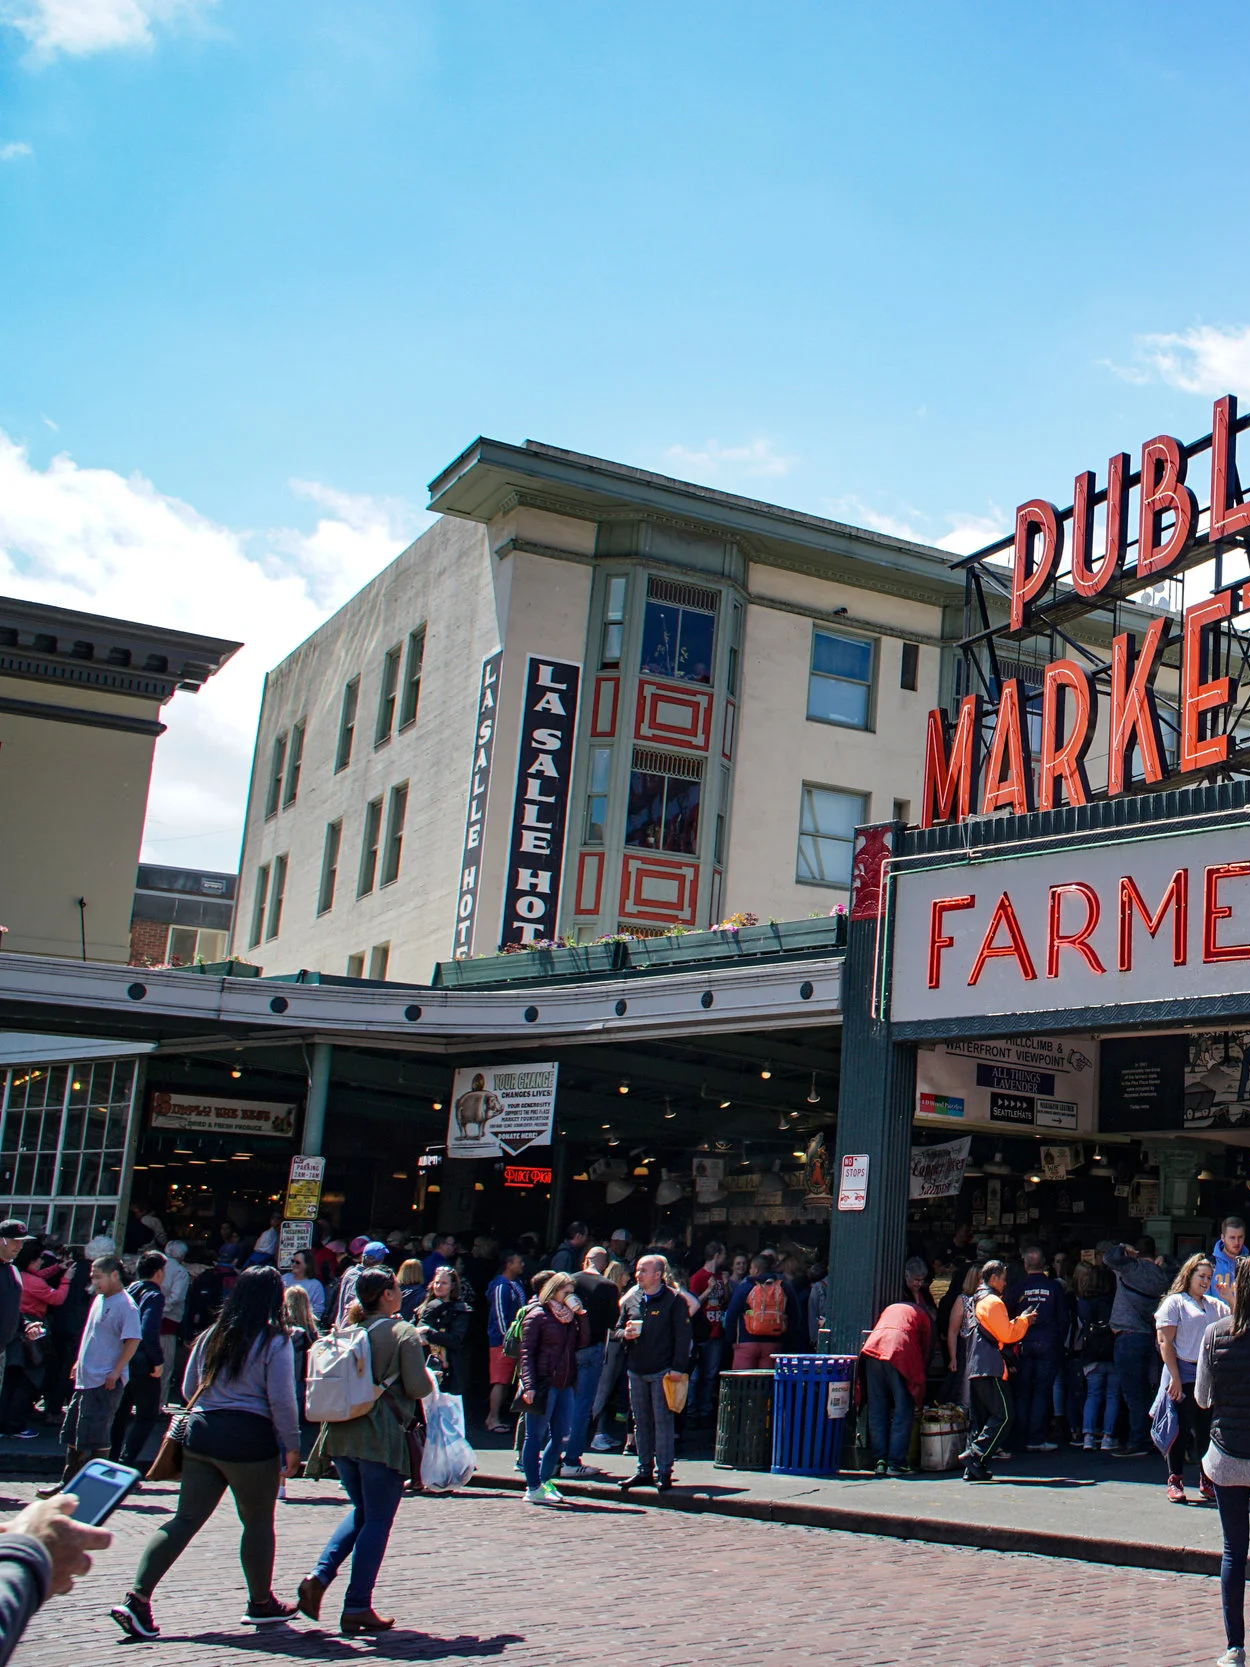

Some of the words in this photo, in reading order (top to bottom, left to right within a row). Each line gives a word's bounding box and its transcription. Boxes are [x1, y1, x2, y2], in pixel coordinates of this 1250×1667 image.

[480, 663, 497, 712] LA
[533, 664, 567, 716] LA
[467, 719, 492, 850] SALLE
[519, 728, 562, 855] SALLE
[511, 868, 551, 945] HOT
[945, 1040, 1011, 1058] WATERFRONT
[1016, 1050, 1065, 1068] VIEWPOINT
[1057, 1043, 1063, 1054] &
[494, 1073, 516, 1091] YOUR
[518, 1071, 554, 1089] CHANGE
[992, 1068, 1009, 1080] ALL
[1011, 1071, 1041, 1083] THINGS
[994, 1079, 1038, 1093] LAVENDER
[501, 1091, 531, 1099] CHANGES
[532, 1089, 552, 1098] LIVES!
[846, 1169, 865, 1177] STOPS
